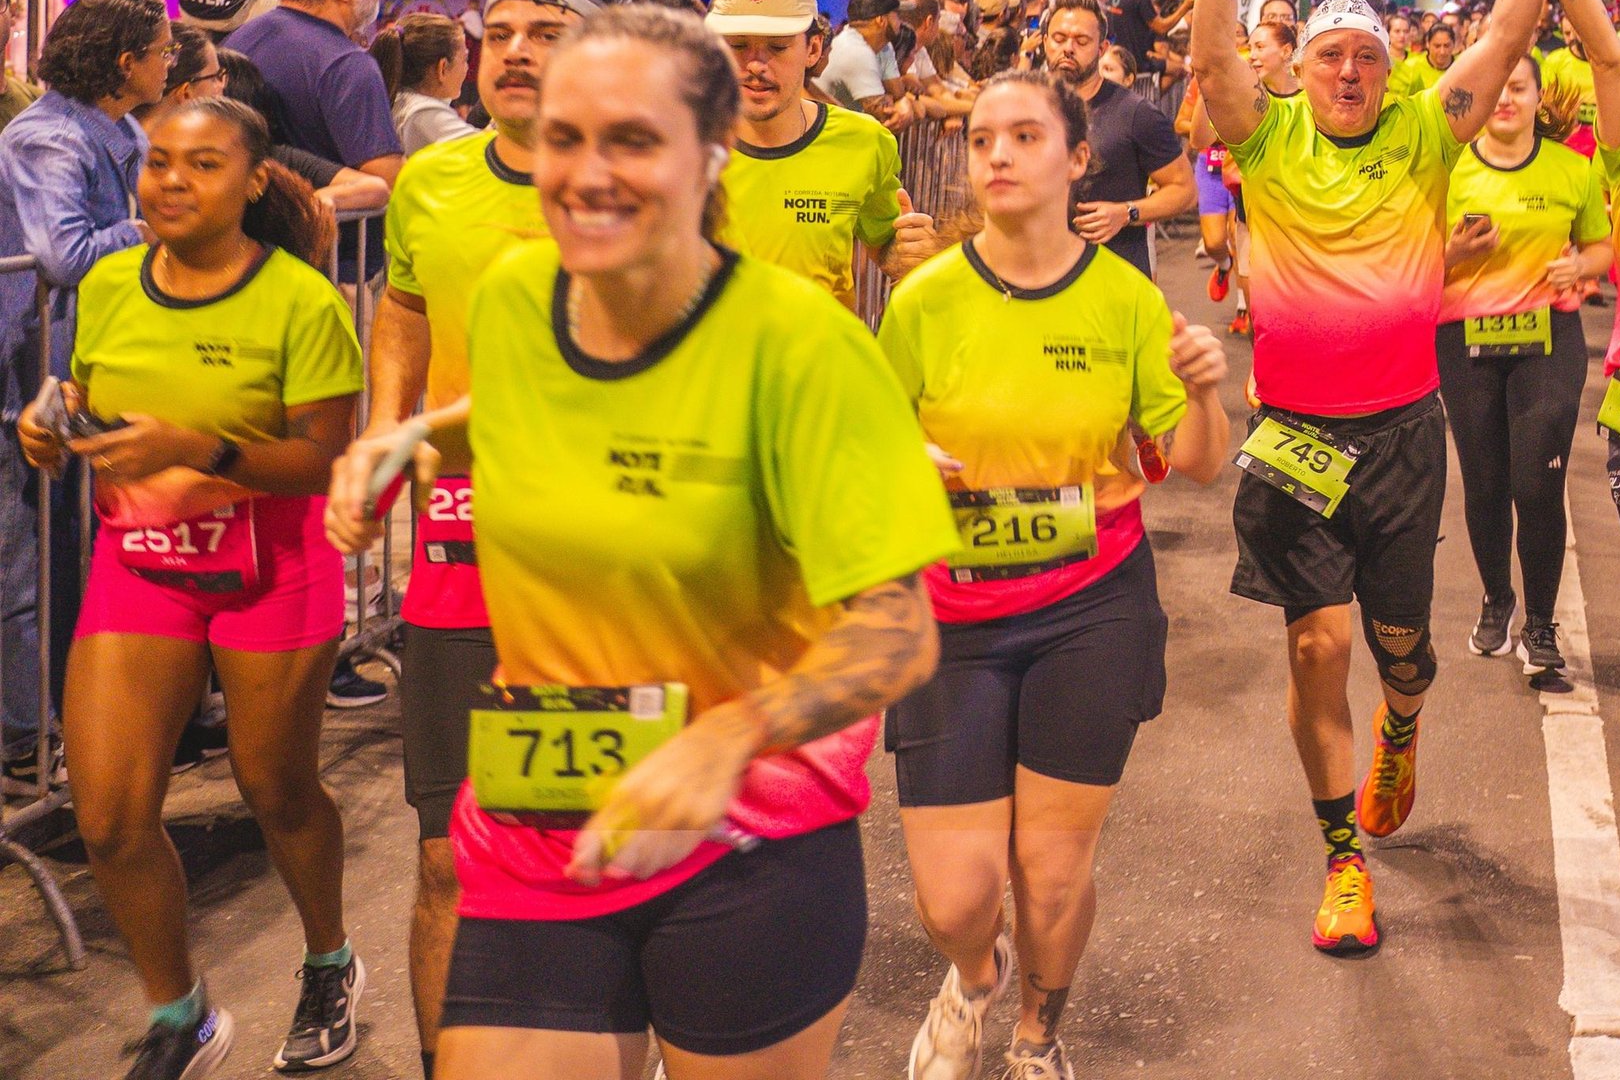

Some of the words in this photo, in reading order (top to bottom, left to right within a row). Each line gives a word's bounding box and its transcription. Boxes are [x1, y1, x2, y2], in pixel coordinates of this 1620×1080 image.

[1359, 160, 1382, 175] NOIT
[784, 198, 827, 209] NOITE
[796, 211, 831, 224] RUN.
[1043, 345, 1086, 356] NOITE
[1273, 430, 1333, 474] 749
[1276, 456, 1306, 477] ROBERTO
[972, 513, 1058, 548] 216
[507, 727, 627, 778] 713
